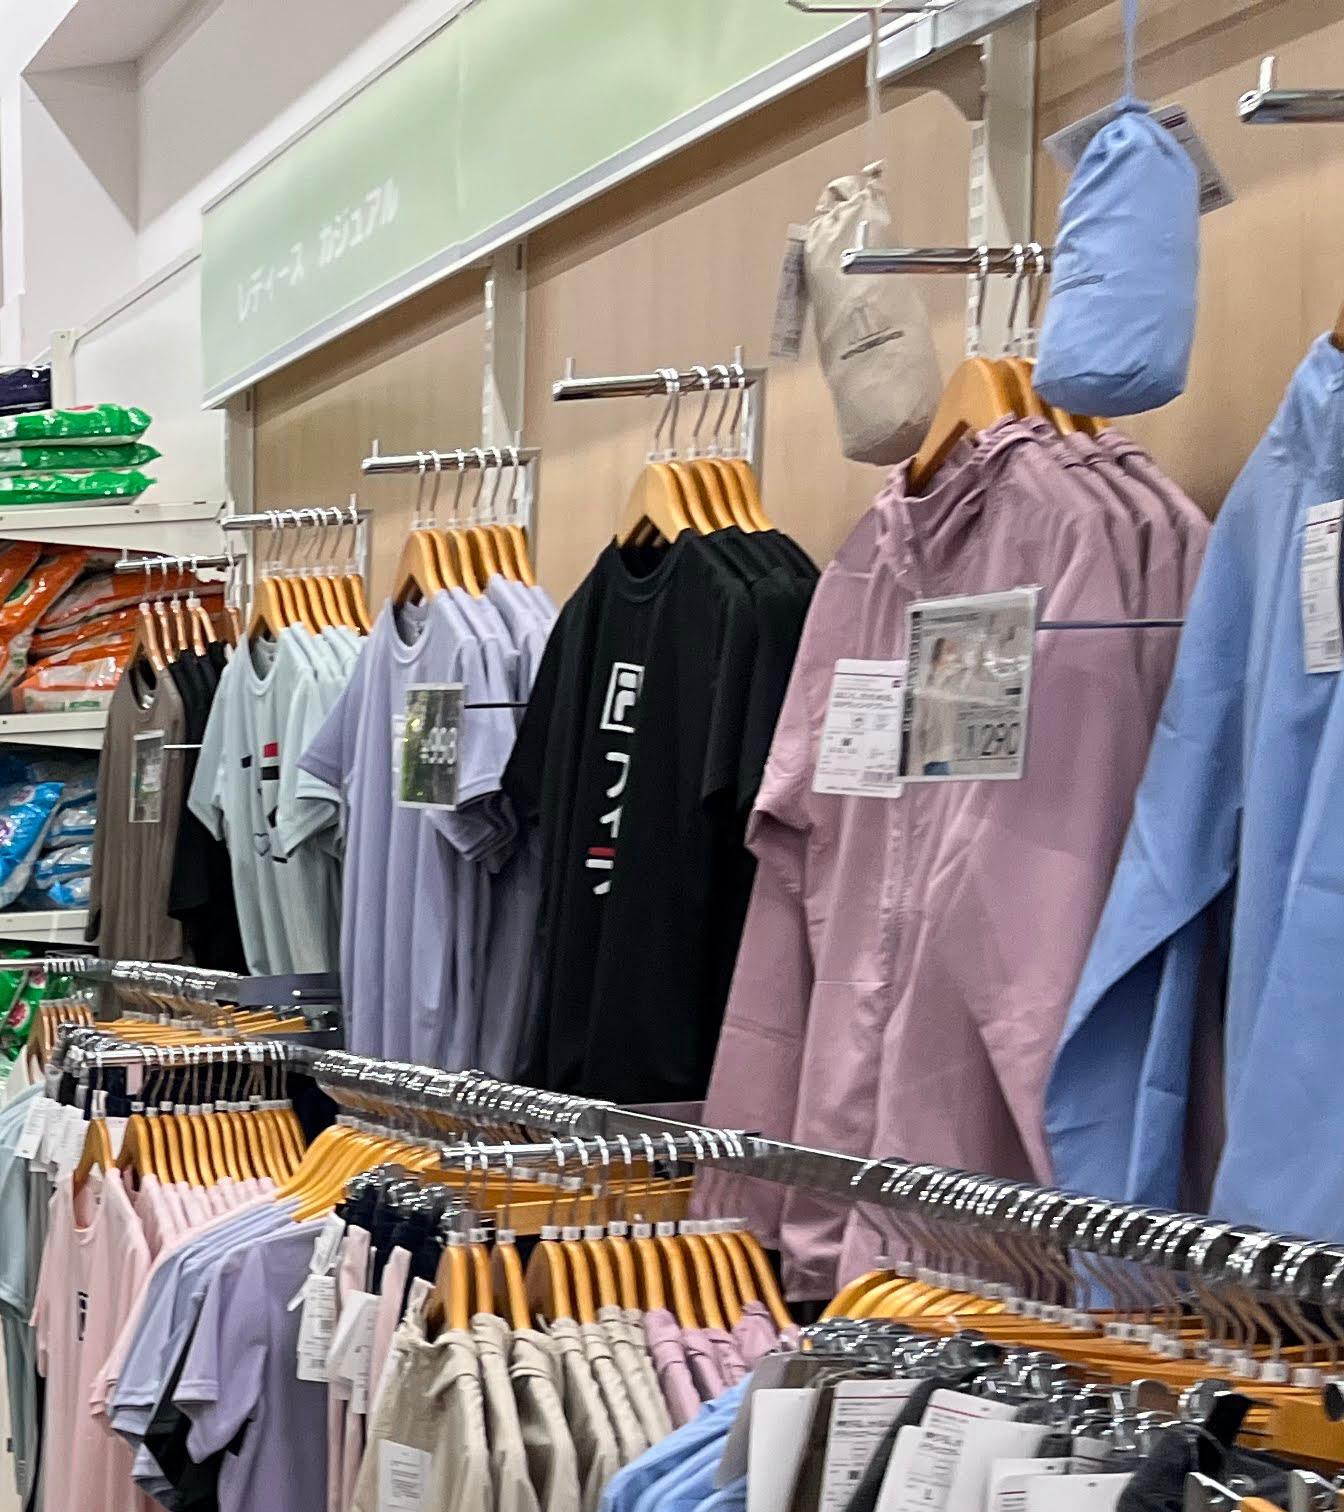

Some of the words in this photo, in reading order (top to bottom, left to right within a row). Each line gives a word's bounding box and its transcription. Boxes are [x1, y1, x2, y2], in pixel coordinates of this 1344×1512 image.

[237, 241, 305, 323] レディース
[319, 176, 400, 269] カジュアル
